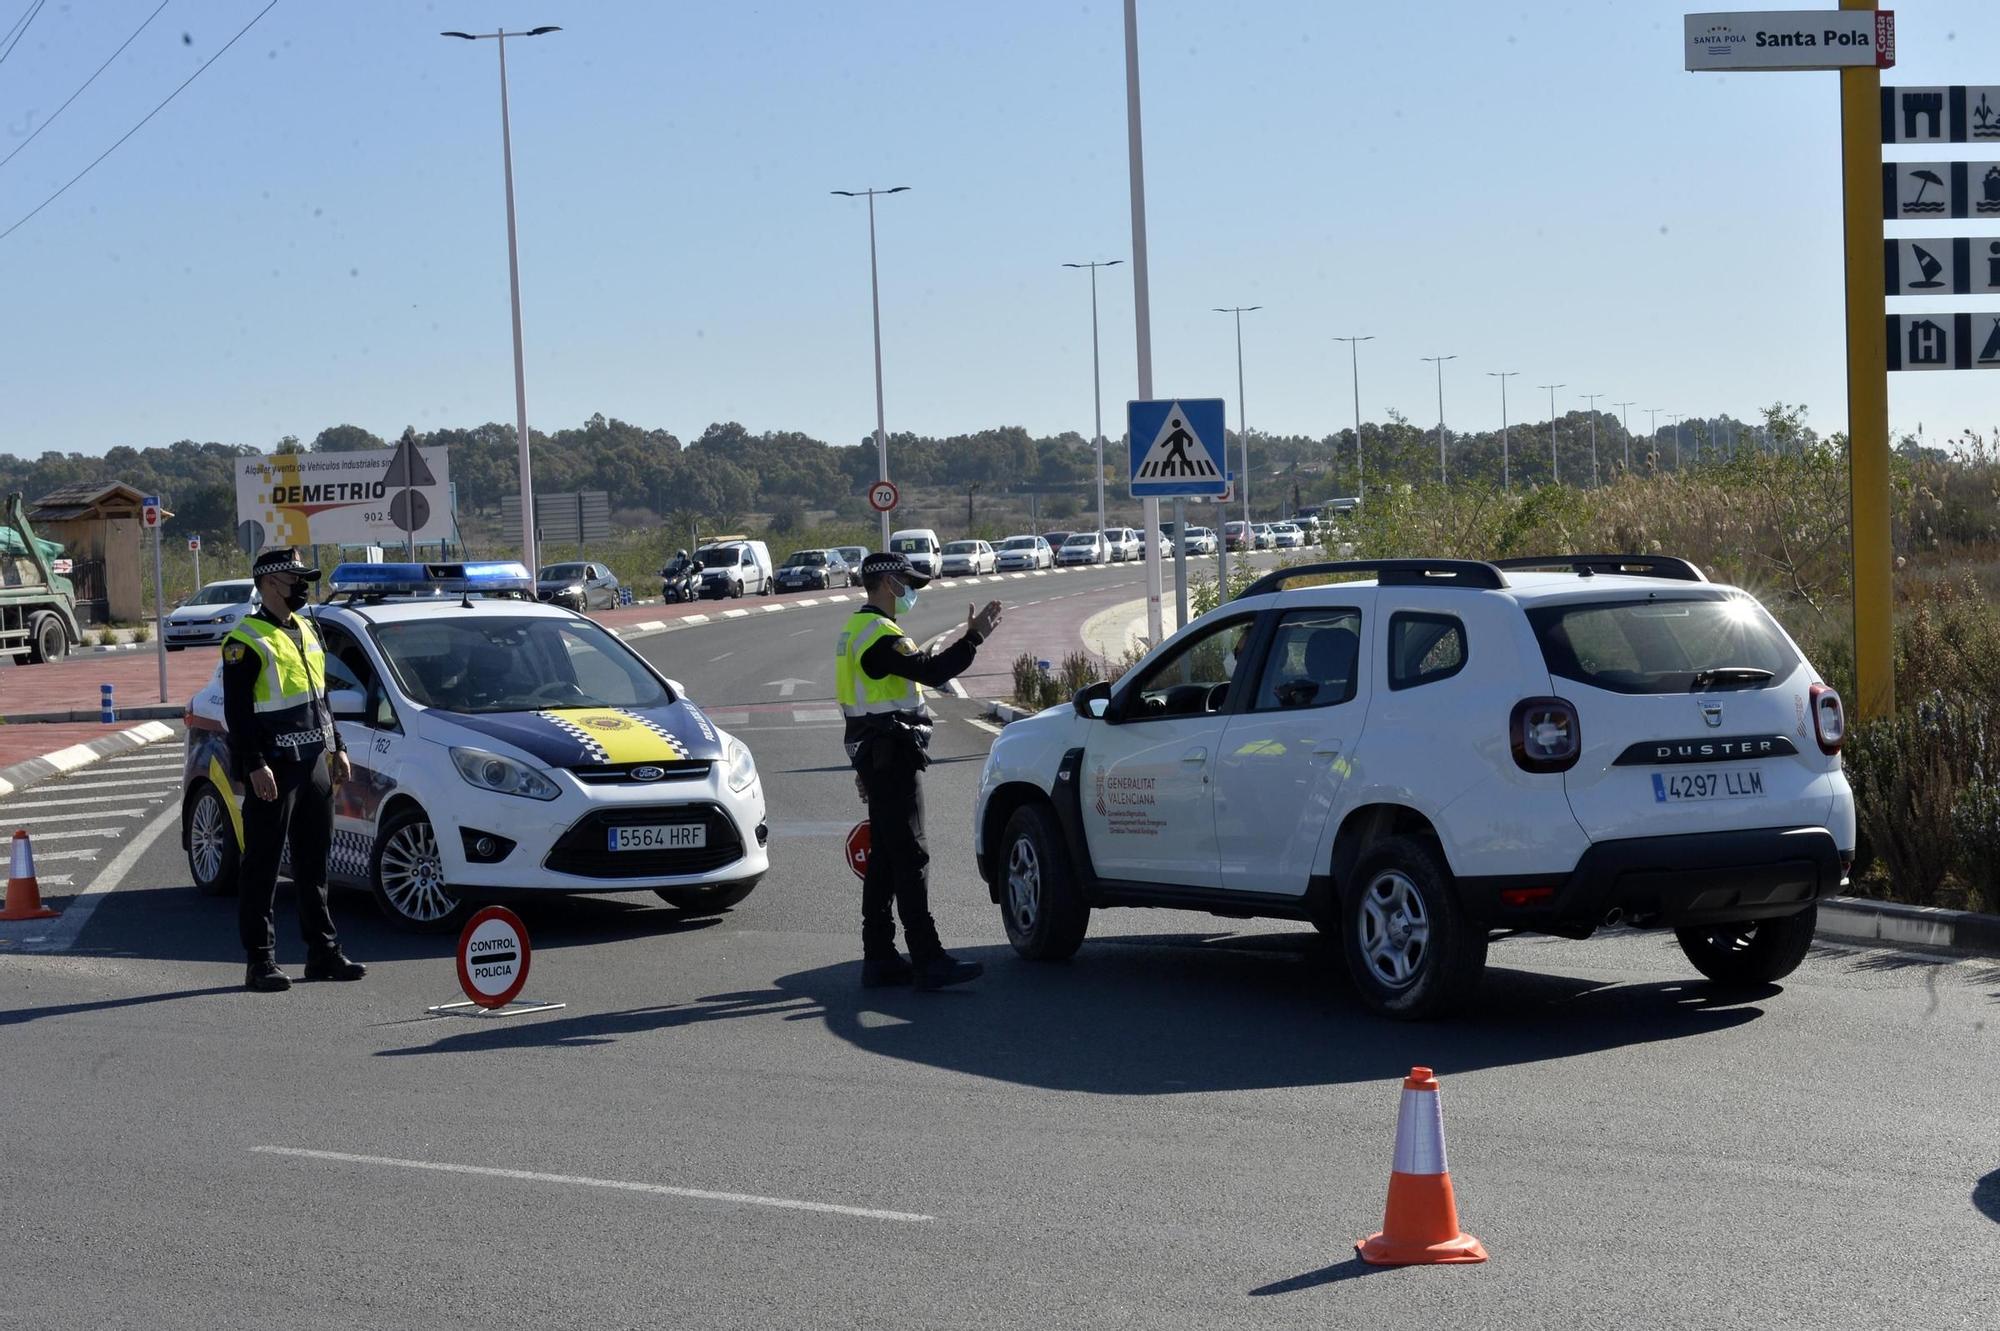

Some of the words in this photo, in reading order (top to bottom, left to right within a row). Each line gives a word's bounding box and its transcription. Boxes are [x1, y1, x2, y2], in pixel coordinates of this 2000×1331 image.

[1694, 35, 1722, 44] SANTA
[1725, 35, 1746, 43] POLA
[1755, 31, 1816, 47] Santa
[1823, 30, 1869, 46] Pola
[1877, 15, 1886, 53] Costa
[1885, 16, 1895, 61] Blanca
[277, 463, 296, 473] venta
[297, 462, 306, 472] de
[272, 481, 386, 504] DEMETRIO
[876, 492, 891, 501] 70
[364, 512, 383, 522] 902
[375, 738, 391, 754] 162
[1657, 741, 1771, 758] DUSTER
[638, 768, 658, 777] Ford
[1107, 777, 1156, 790] GENERALITAT
[1670, 773, 1718, 799] 4297
[1724, 771, 1764, 796] LLM
[1107, 793, 1155, 806] VALENCIANA
[620, 828, 664, 848] 5564
[670, 827, 702, 846] HRF
[470, 938, 516, 952] CONTROL
[475, 965, 512, 979] POLICIA
